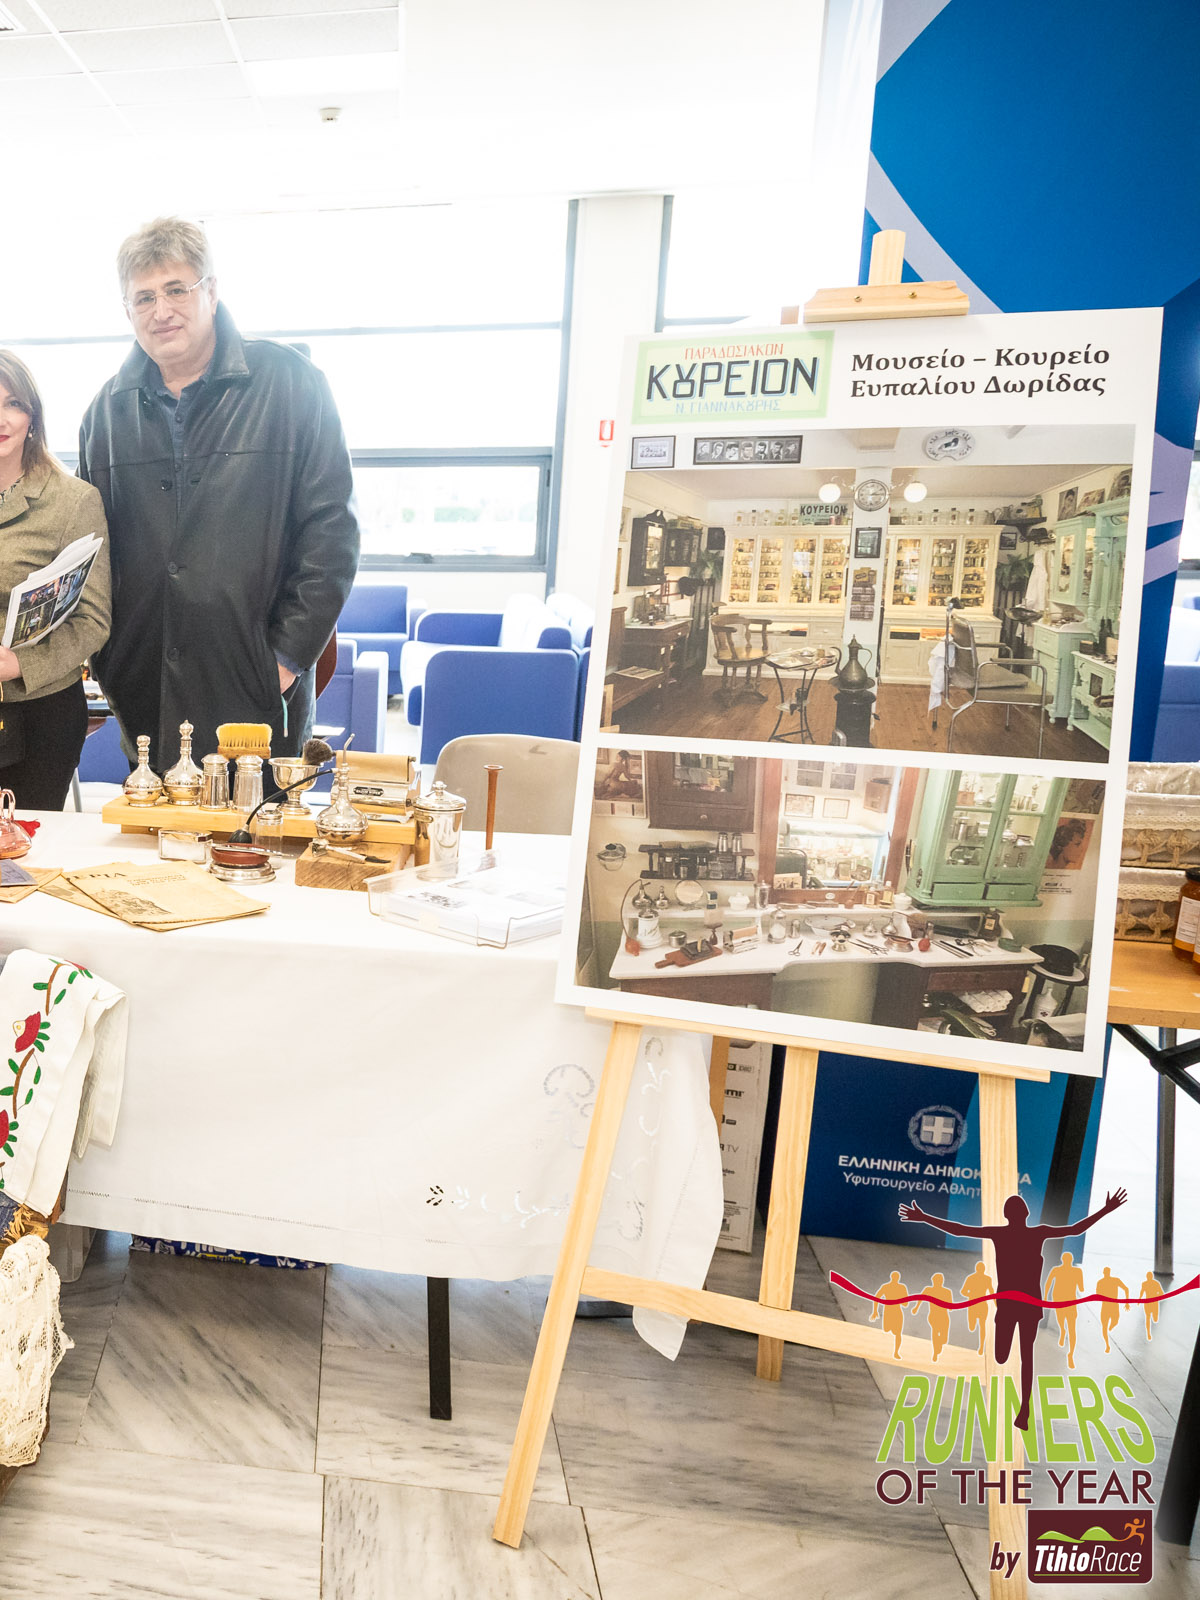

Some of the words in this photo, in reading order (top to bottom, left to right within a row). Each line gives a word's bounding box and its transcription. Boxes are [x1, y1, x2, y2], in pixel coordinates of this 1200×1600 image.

[684, 343, 784, 361] ΠΑΡΑΔΟΣΙΑΚΟΝ
[851, 348, 965, 371] Μουσείο
[994, 343, 1110, 370] Κουρείο
[850, 375, 976, 398] Ευπαλίου
[983, 371, 1106, 397] Δωρίδας
[838, 1154, 920, 1174] ΕΛΛΗΝΙΚΗ
[923, 1164, 1032, 1185] ΔΗΜΟΚΑ
[843, 1171, 935, 1192] Υφυπουργείο
